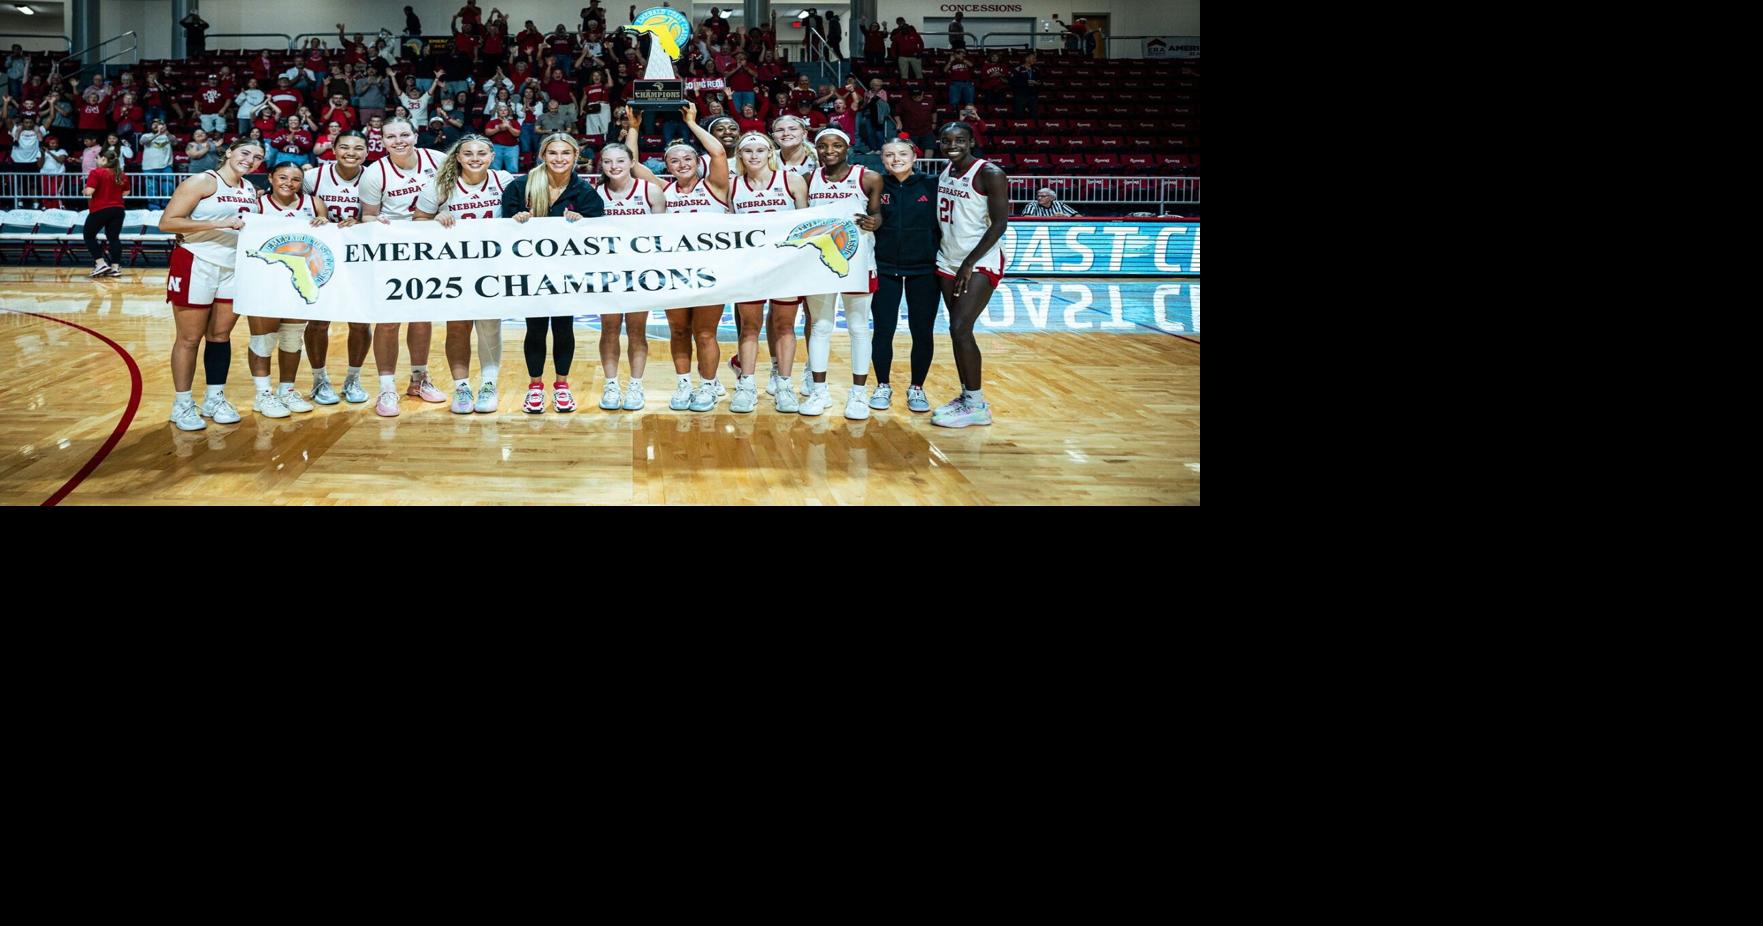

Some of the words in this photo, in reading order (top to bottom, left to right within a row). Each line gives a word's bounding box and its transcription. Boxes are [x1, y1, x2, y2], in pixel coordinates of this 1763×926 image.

[940, 4, 1022, 12] CONCESSIONS
[634, 91, 681, 99] CHAMPIONS
[408, 102, 420, 110] 33
[368, 140, 383, 152] 33
[387, 183, 426, 197] NEBRA
[938, 186, 971, 199] EBRASKA
[736, 198, 787, 209] NEBRASKA
[602, 208, 646, 216] EBRASKA
[939, 197, 955, 225] 21
[344, 240, 502, 262] EMERALD
[512, 236, 621, 258] COAST
[630, 229, 766, 254] CLASSIC
[168, 275, 183, 292] N
[386, 276, 463, 301] 2025
[474, 267, 717, 298] CHAMPIONS
